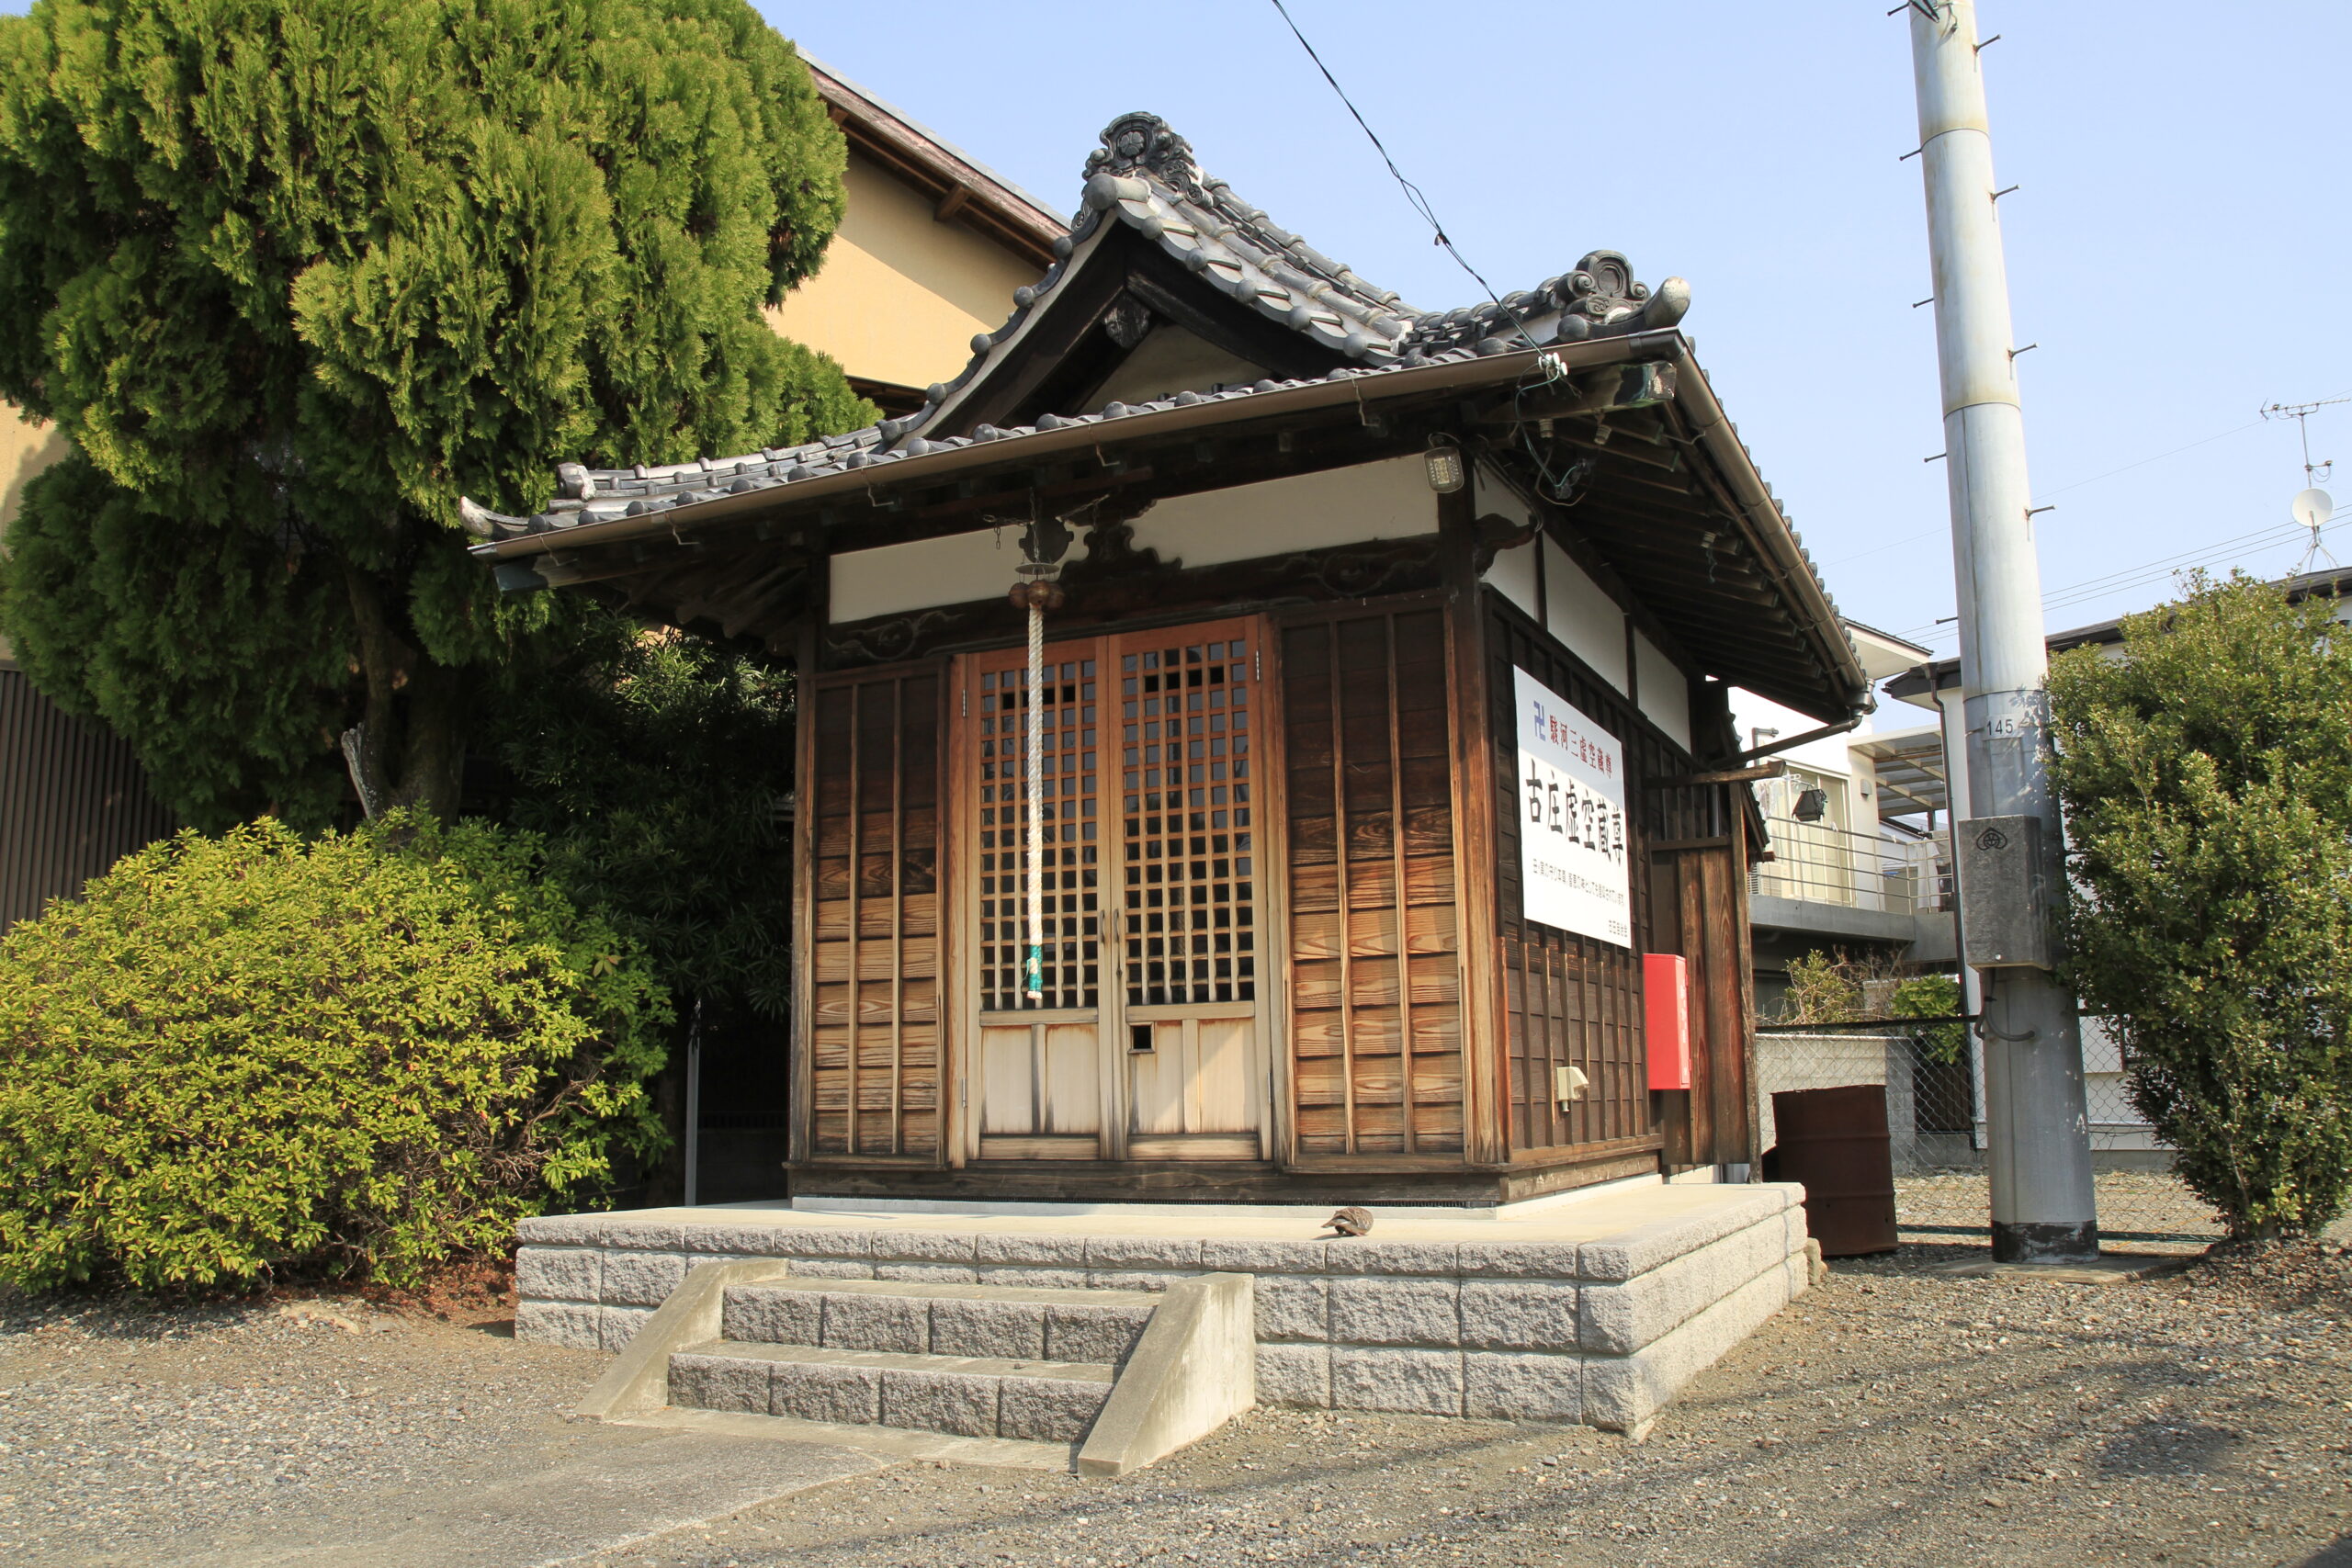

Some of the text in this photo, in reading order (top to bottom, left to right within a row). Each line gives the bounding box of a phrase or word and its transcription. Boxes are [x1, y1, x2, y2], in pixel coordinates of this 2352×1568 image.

[1986, 718, 2014, 736] 145
[1526, 758, 1623, 867] 古庄虚空蔵尊
